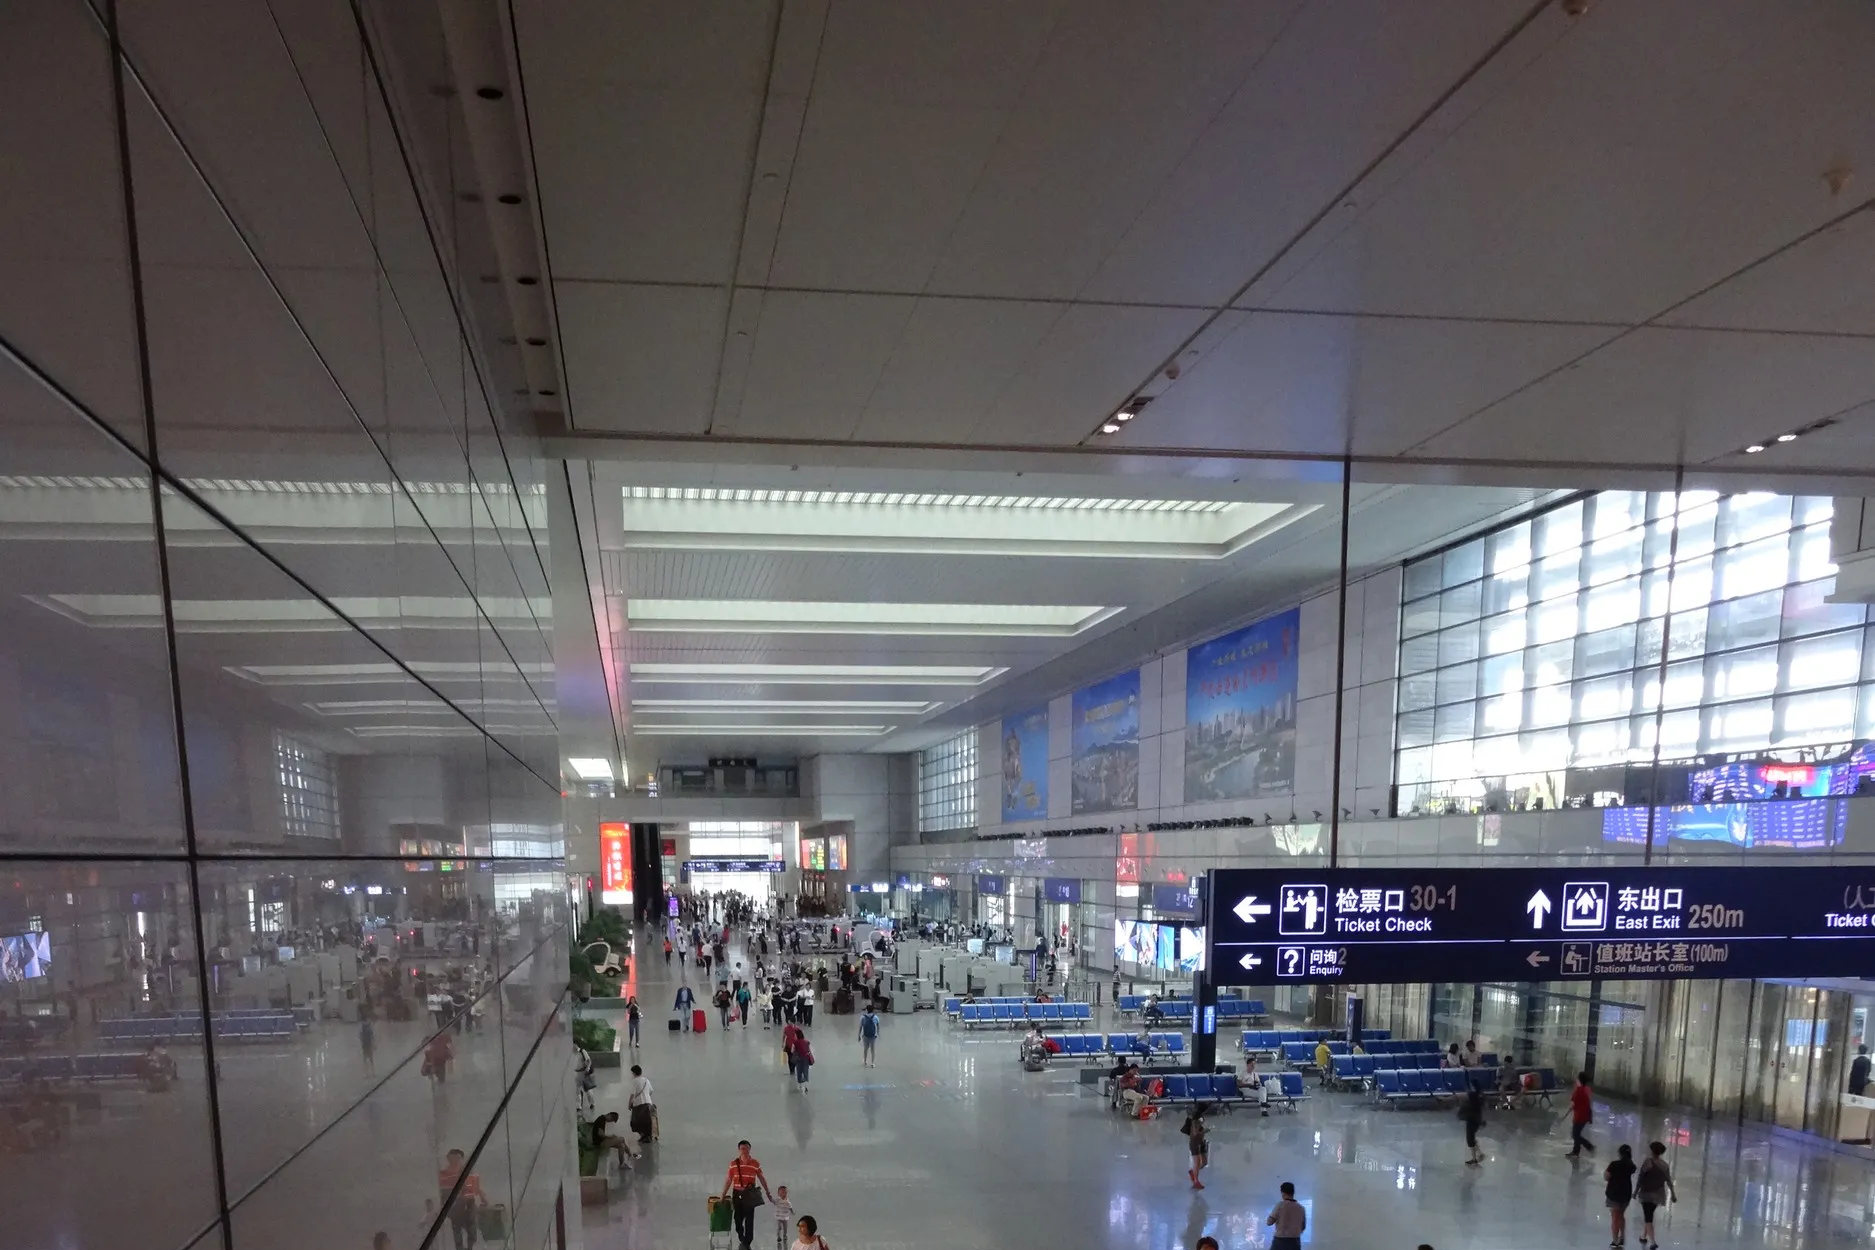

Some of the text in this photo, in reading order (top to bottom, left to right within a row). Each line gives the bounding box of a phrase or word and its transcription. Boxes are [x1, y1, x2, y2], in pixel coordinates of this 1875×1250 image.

[1335, 885, 1457, 914] 检票口 30-1
[1617, 886, 1684, 912] 东出口
[1615, 915, 1681, 930] East Exit
[1687, 903, 1745, 929] 250m
[1824, 913, 1868, 927] Ticket
[1335, 917, 1433, 932] Ticket Check
[1309, 965, 1344, 976] Enquiry
[1594, 963, 1695, 974] Station Master's Office
